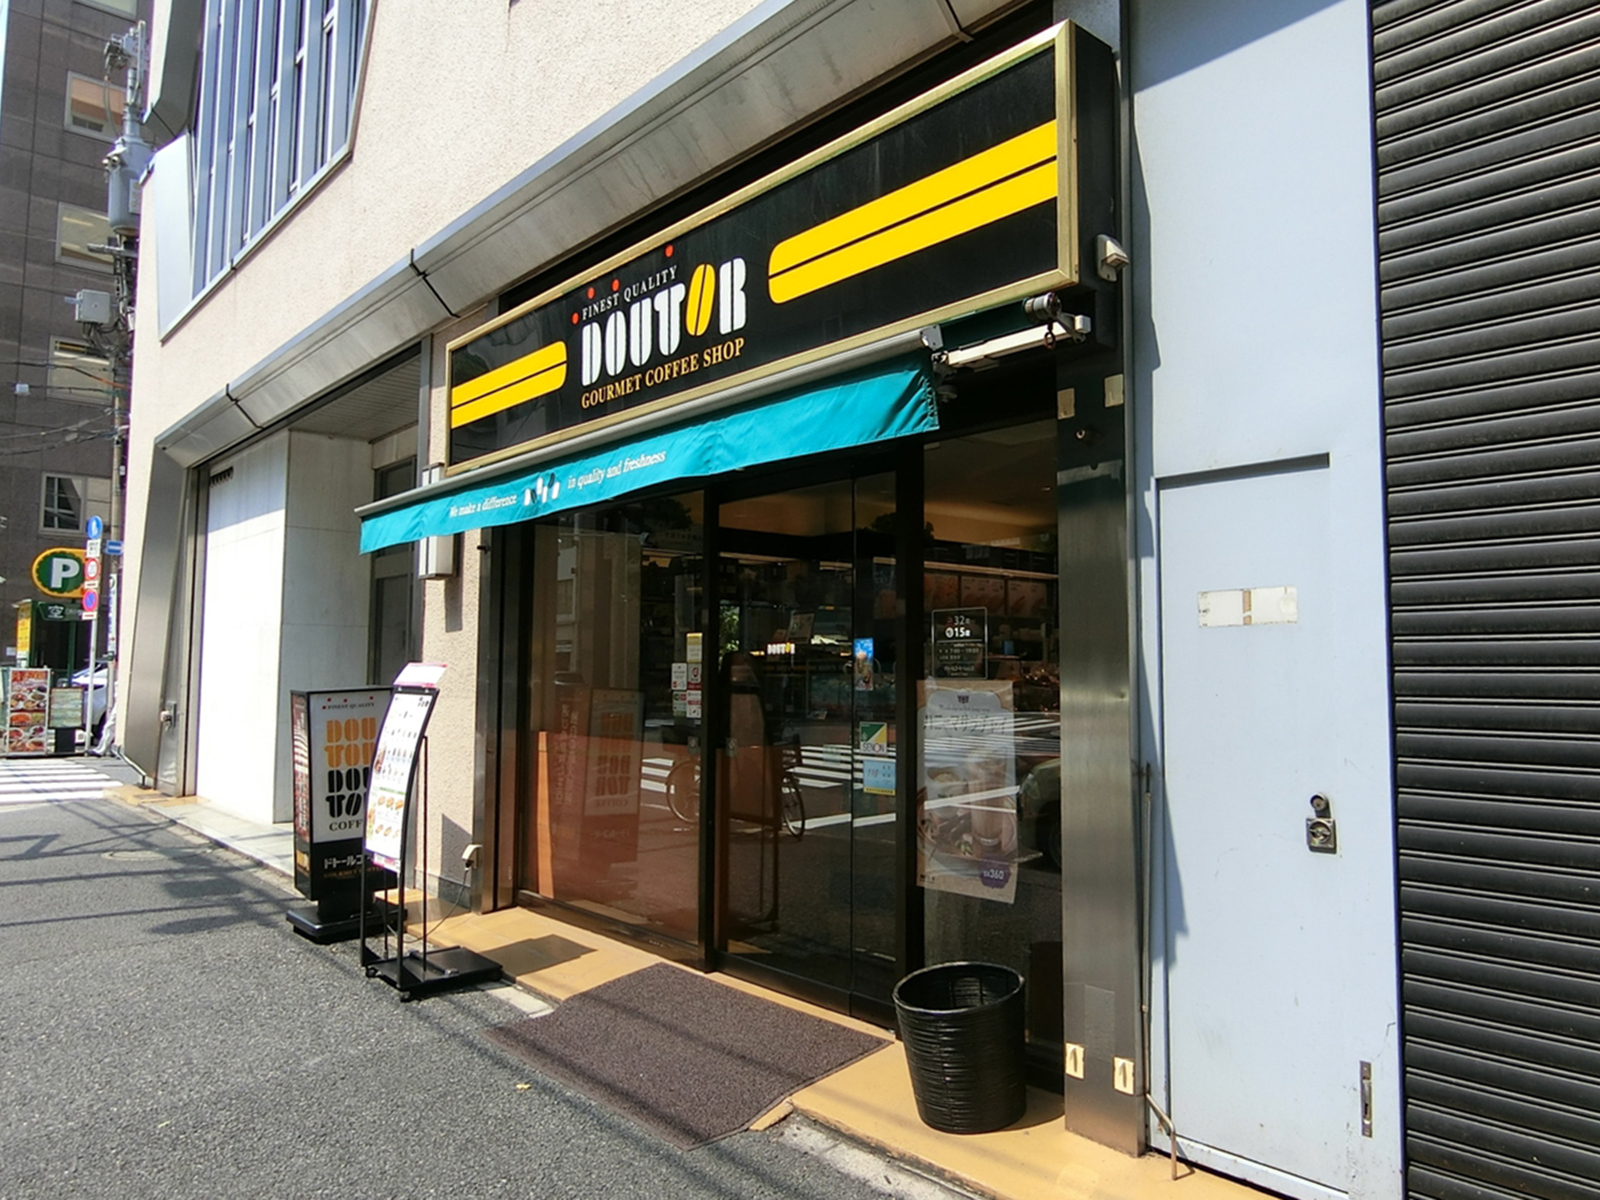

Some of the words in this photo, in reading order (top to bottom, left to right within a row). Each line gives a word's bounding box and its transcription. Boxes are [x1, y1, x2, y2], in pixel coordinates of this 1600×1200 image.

[582, 293, 619, 320] FINEST
[624, 265, 677, 302] QUALITY
[582, 257, 746, 387] DOUTOR
[581, 374, 642, 409] GOURMET
[645, 353, 699, 387] COFFEE
[702, 337, 745, 368] SHOP
[459, 502, 476, 517] make
[482, 494, 518, 511] difference
[567, 475, 576, 489] in
[578, 468, 605, 491] quality
[606, 460, 622, 479] and
[623, 451, 667, 473] freshness
[50, 558, 80, 588] P
[326, 717, 376, 744] DOU
[325, 792, 368, 819] TO
